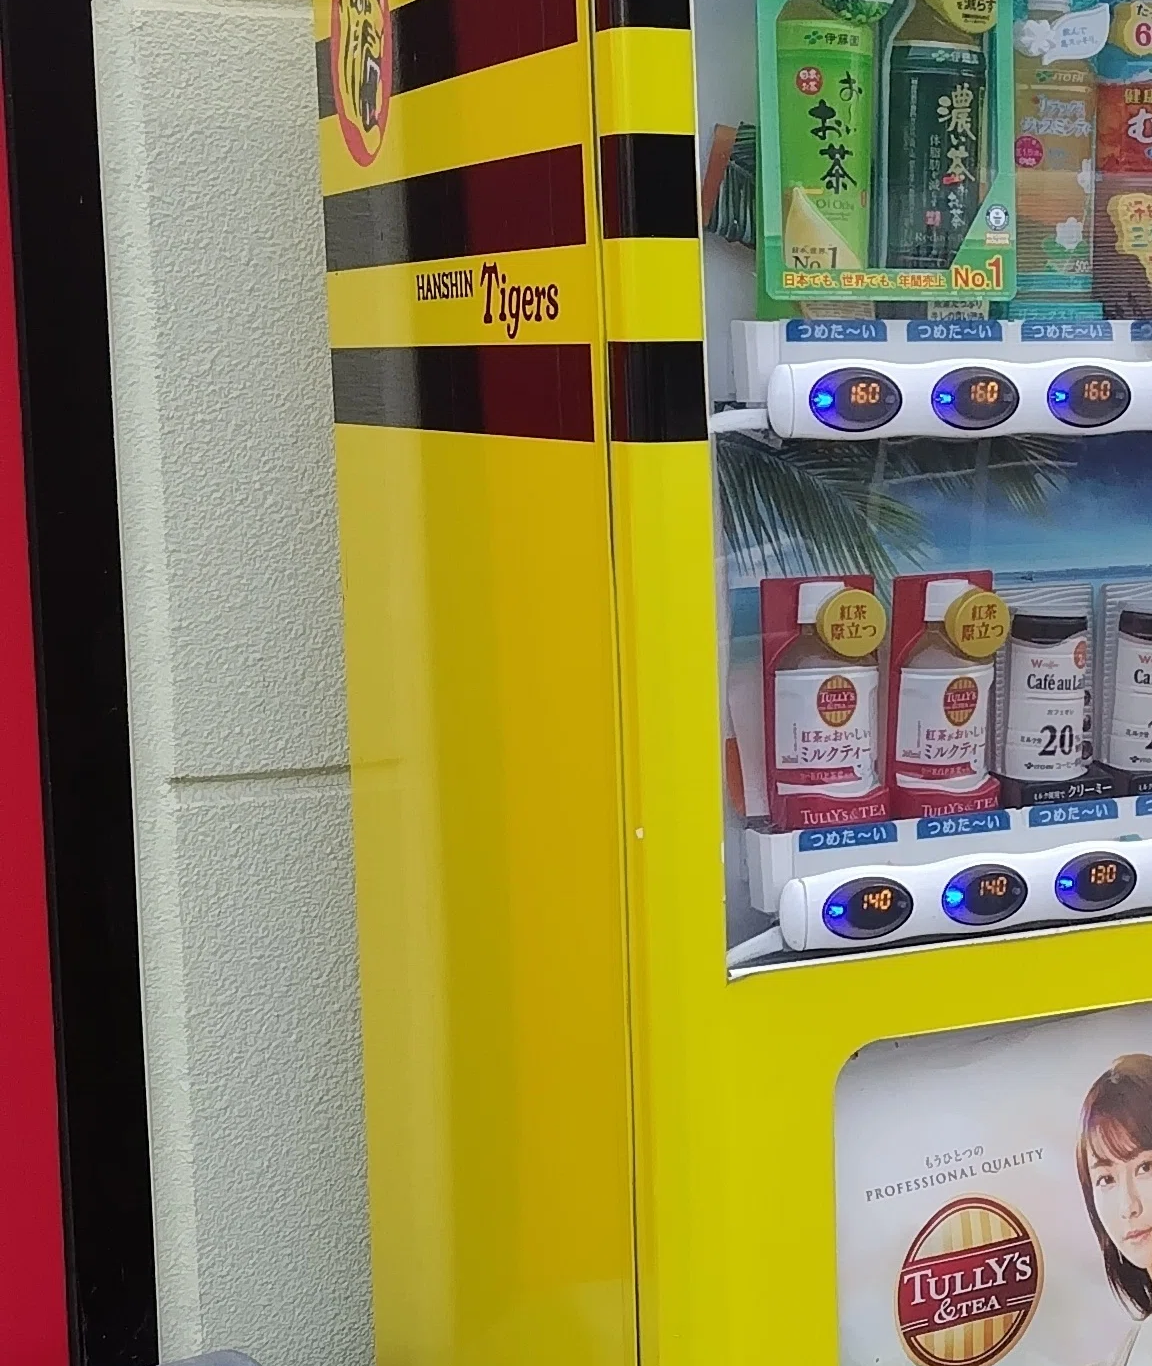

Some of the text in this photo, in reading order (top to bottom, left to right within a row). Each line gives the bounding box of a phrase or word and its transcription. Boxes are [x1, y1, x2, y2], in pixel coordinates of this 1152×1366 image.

[936, 82, 977, 183] 濃い茶
[808, 98, 858, 195] お茶
[954, 256, 1003, 288] No.1
[415, 261, 561, 339] HANSHIN Tigers
[850, 382, 880, 404] 160
[970, 381, 998, 403] 160
[1084, 380, 1111, 401] 160
[839, 603, 868, 621] 紅茶
[971, 602, 997, 620] 紅茶
[831, 622, 878, 641] 際立つ
[960, 621, 1004, 641] 際立つ
[1026, 673, 1055, 691] Café
[801, 727, 872, 743] 紅茶がおいしい
[800, 745, 872, 763] ミルクティー
[924, 742, 986, 760] ミルクティー
[1067, 784, 1113, 799] クリーミー
[1089, 864, 1117, 884] 130
[979, 876, 1008, 897] 140
[863, 888, 892, 910] 140
[923, 1145, 985, 1171] もうひとつの
[865, 1146, 1045, 1203] PROFESSIONAL QUALITY
[903, 1249, 1034, 1309] TULLY'S
